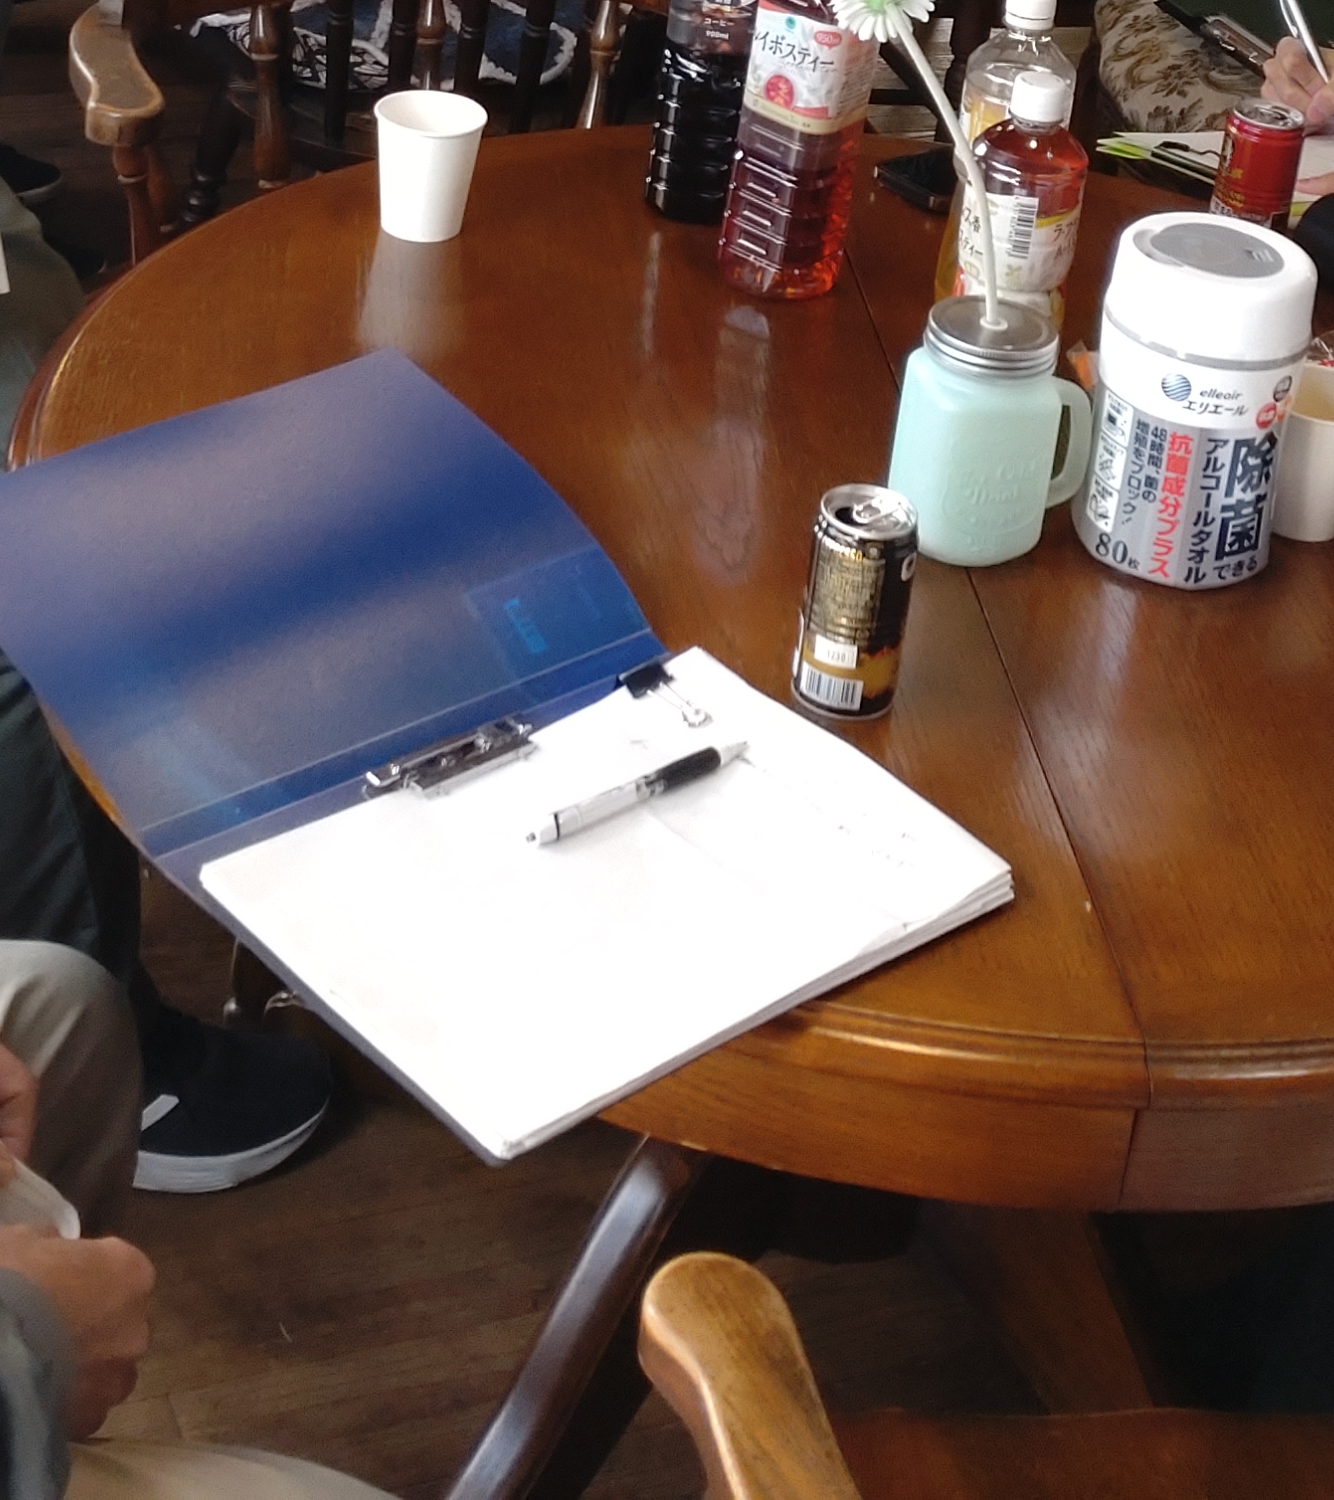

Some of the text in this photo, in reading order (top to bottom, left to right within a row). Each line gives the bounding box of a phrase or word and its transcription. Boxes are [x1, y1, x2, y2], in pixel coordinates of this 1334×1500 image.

[704, 17, 736, 27] コーヒー
[1182, 400, 1250, 415] エリエール
[1199, 388, 1243, 401] elleair
[1148, 431, 1195, 579] 抗菌成分プラス
[1183, 437, 1230, 584] アルコールタオル
[1215, 430, 1278, 561] 除菌
[1095, 531, 1140, 571] 80枚
[1213, 558, 1259, 580] できる
